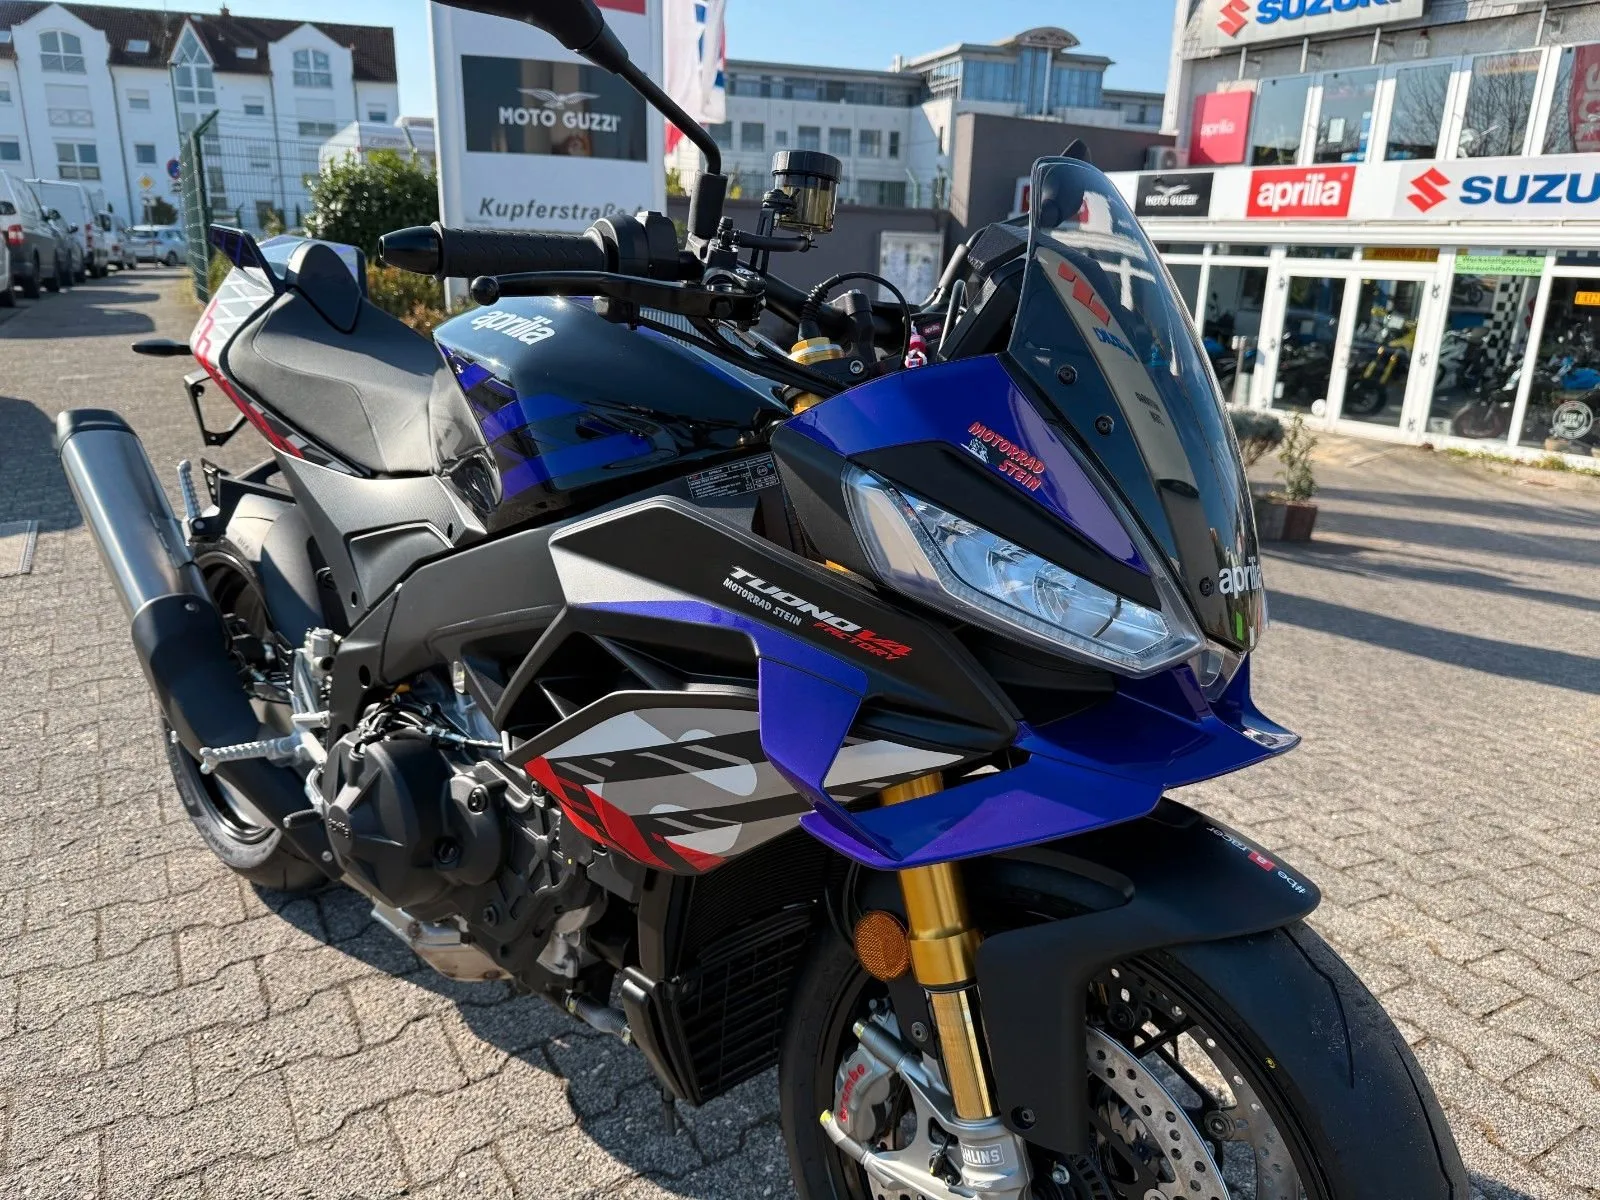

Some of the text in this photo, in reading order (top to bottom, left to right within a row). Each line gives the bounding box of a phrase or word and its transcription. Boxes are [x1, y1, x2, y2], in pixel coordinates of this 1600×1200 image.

[1255, 0, 1403, 24] SUZ
[498, 106, 618, 132] MOTO GUZZI
[1145, 194, 1199, 206] MOTO GUZZI
[1256, 173, 1341, 212] aprilia
[1459, 173, 1600, 205] SUZU
[471, 310, 556, 345] aprilia
[967, 421, 1045, 474] MOTORRAD
[998, 459, 1041, 492] STEIN
[1218, 556, 1263, 599] aprilia
[722, 577, 802, 627] MOTORRAD STEIN
[731, 565, 912, 656] TUONO V4
[813, 622, 900, 660] FACTORY
[1206, 827, 1247, 851] racer
[1277, 870, 1306, 894] #be
